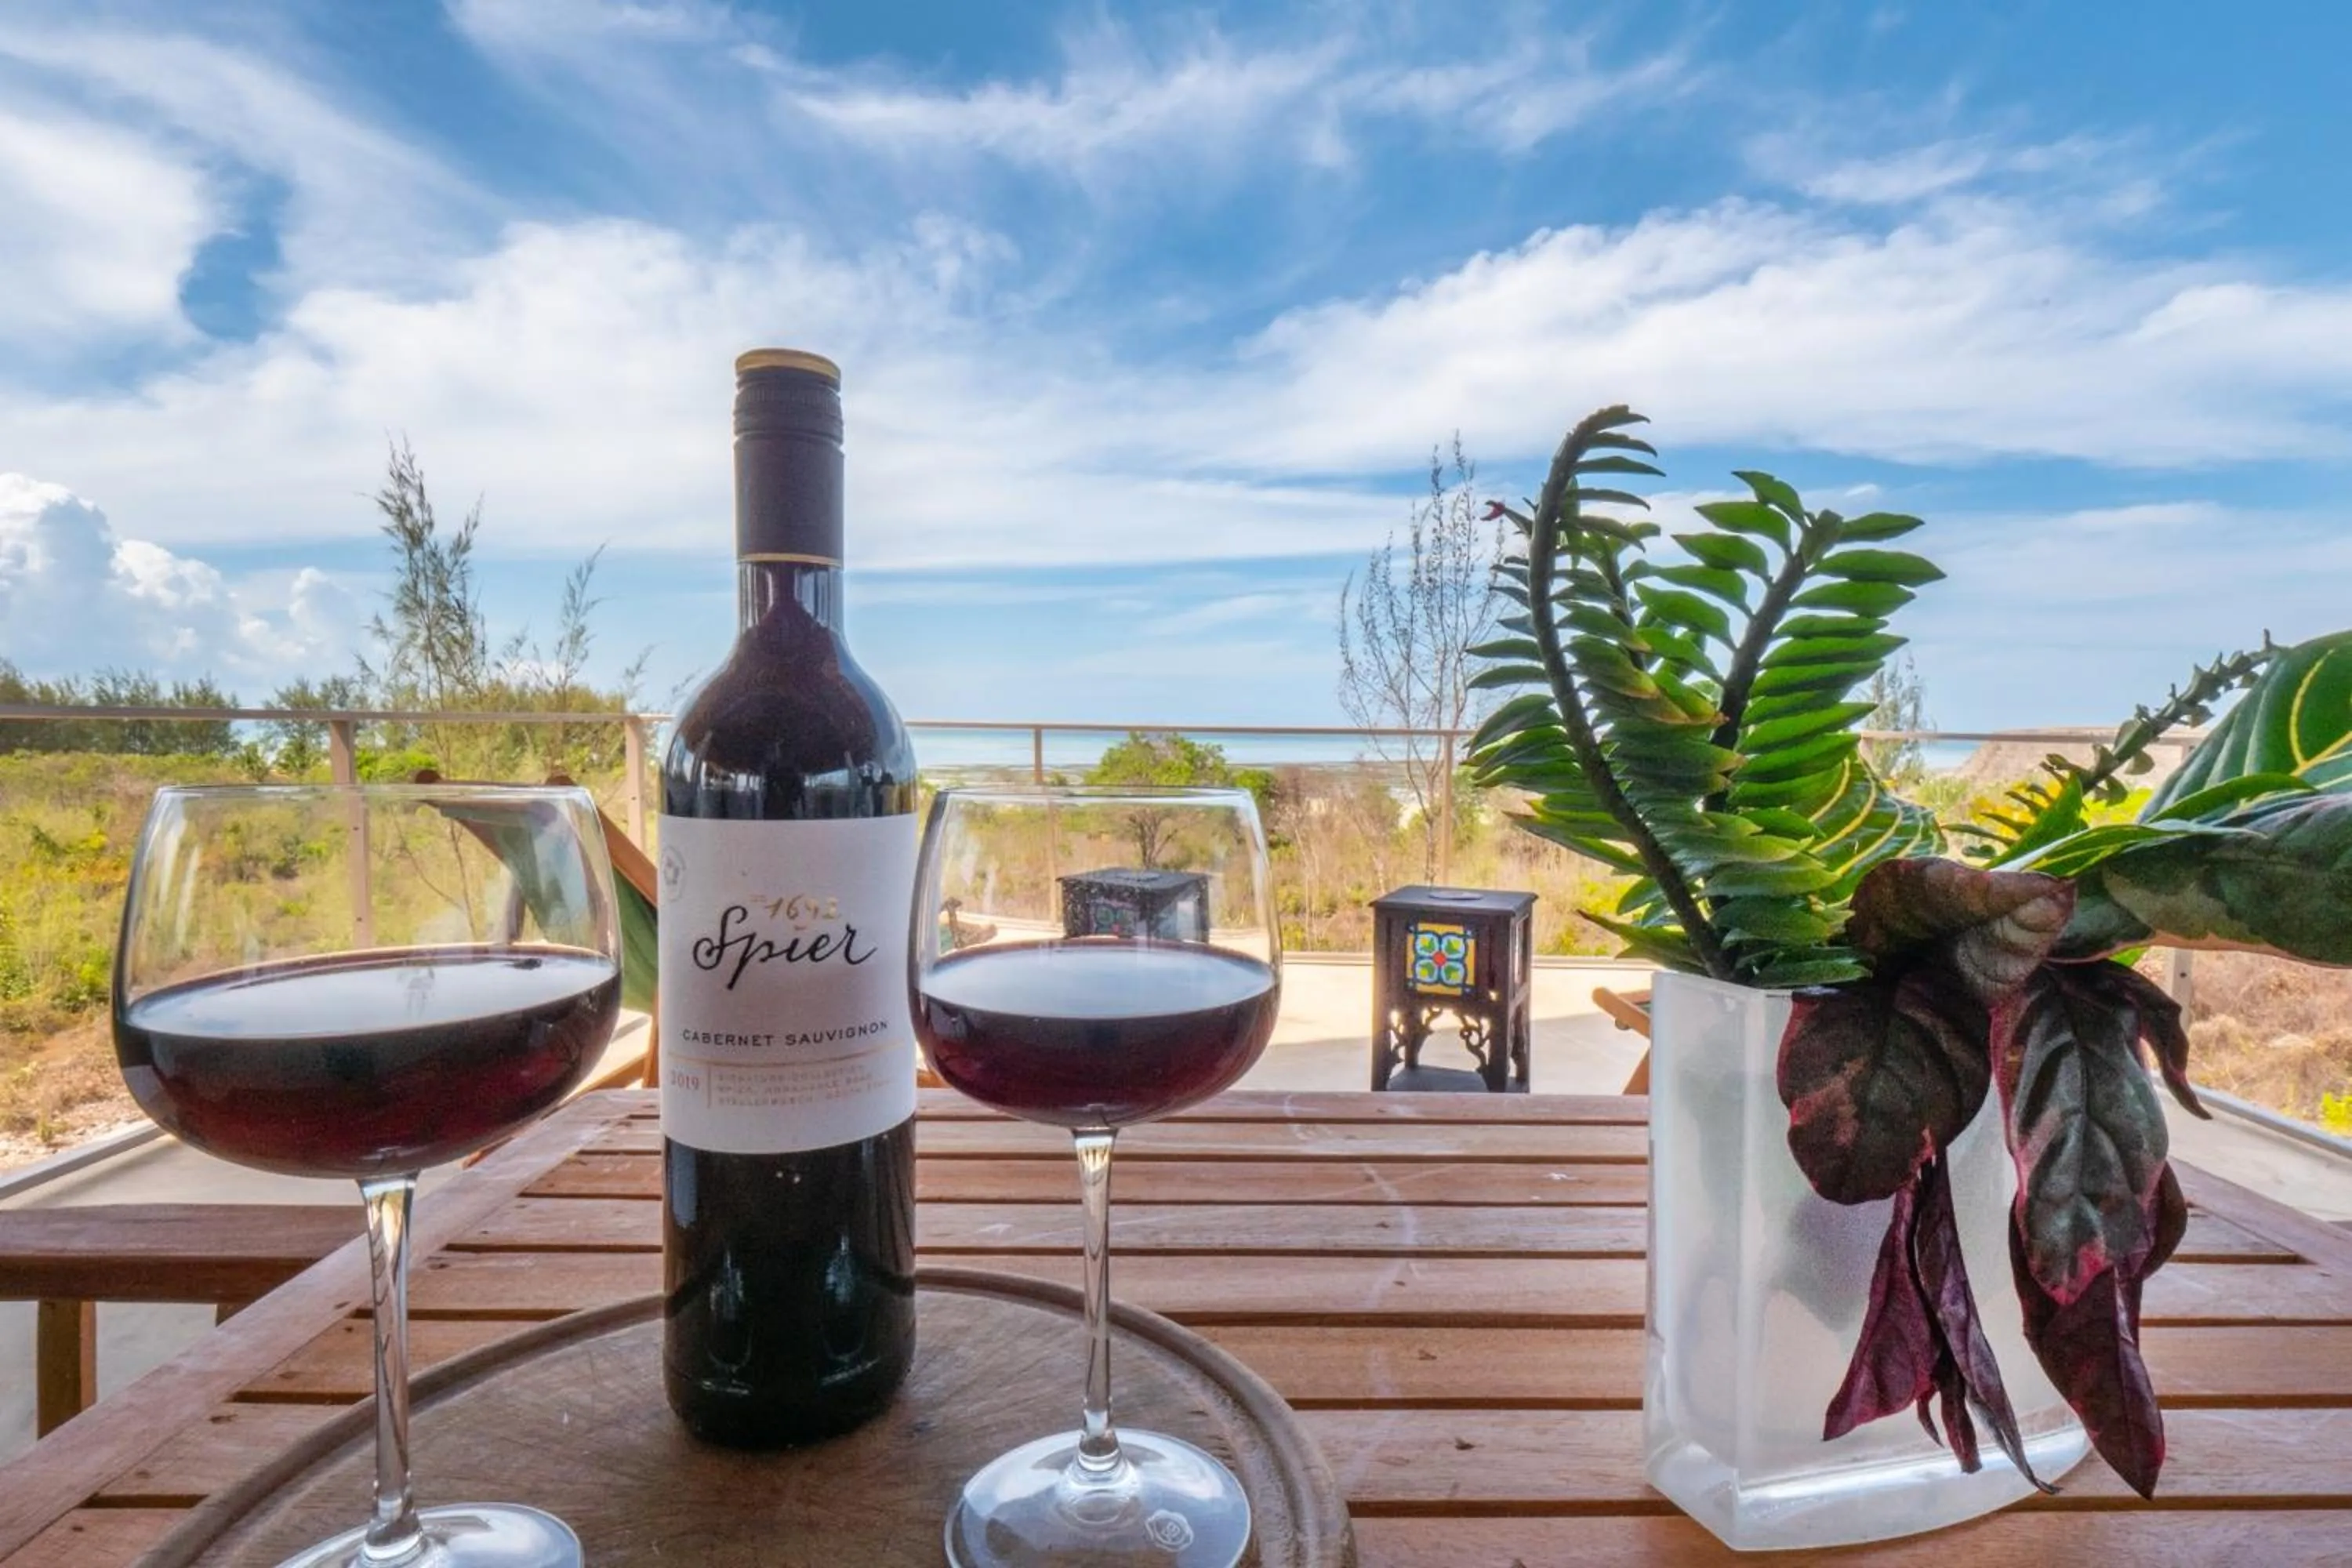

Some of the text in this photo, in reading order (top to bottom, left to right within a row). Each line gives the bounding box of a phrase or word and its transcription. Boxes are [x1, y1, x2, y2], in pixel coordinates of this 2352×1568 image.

[693, 906, 877, 990] Spier
[682, 1022, 887, 1047] CABERNET SAUVIGNON
[670, 1071, 699, 1091] 2019
